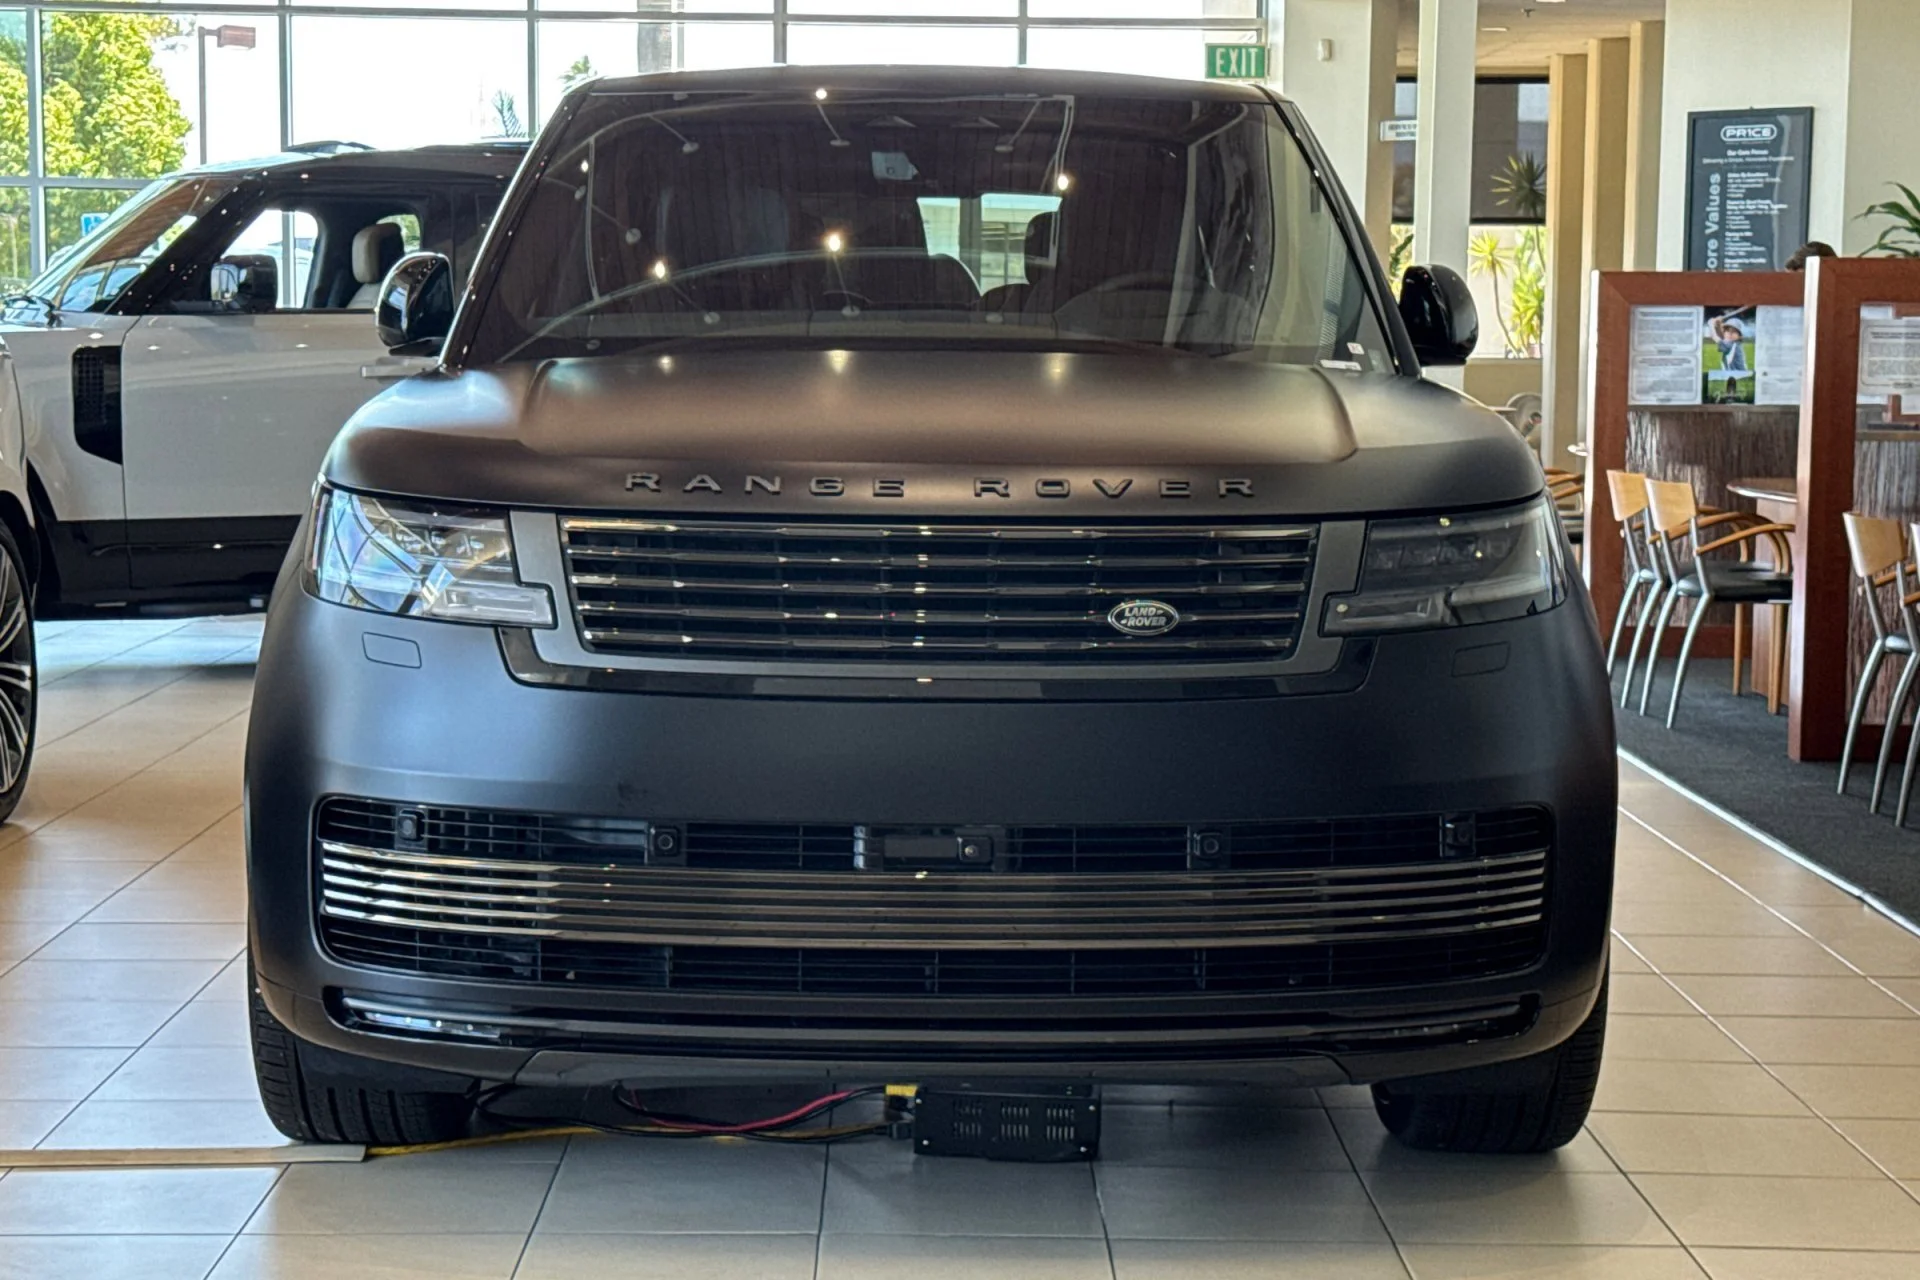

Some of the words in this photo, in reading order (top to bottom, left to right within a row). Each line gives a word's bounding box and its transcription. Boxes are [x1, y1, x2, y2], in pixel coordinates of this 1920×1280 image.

[1215, 47, 1259, 77] EXIT
[1705, 172, 1721, 235] Values
[1705, 238, 1719, 272] ore
[625, 472, 904, 497] RANGE
[973, 477, 1254, 498] ROVER
[1124, 607, 1157, 617] LAND
[1127, 616, 1166, 627] ROVER
